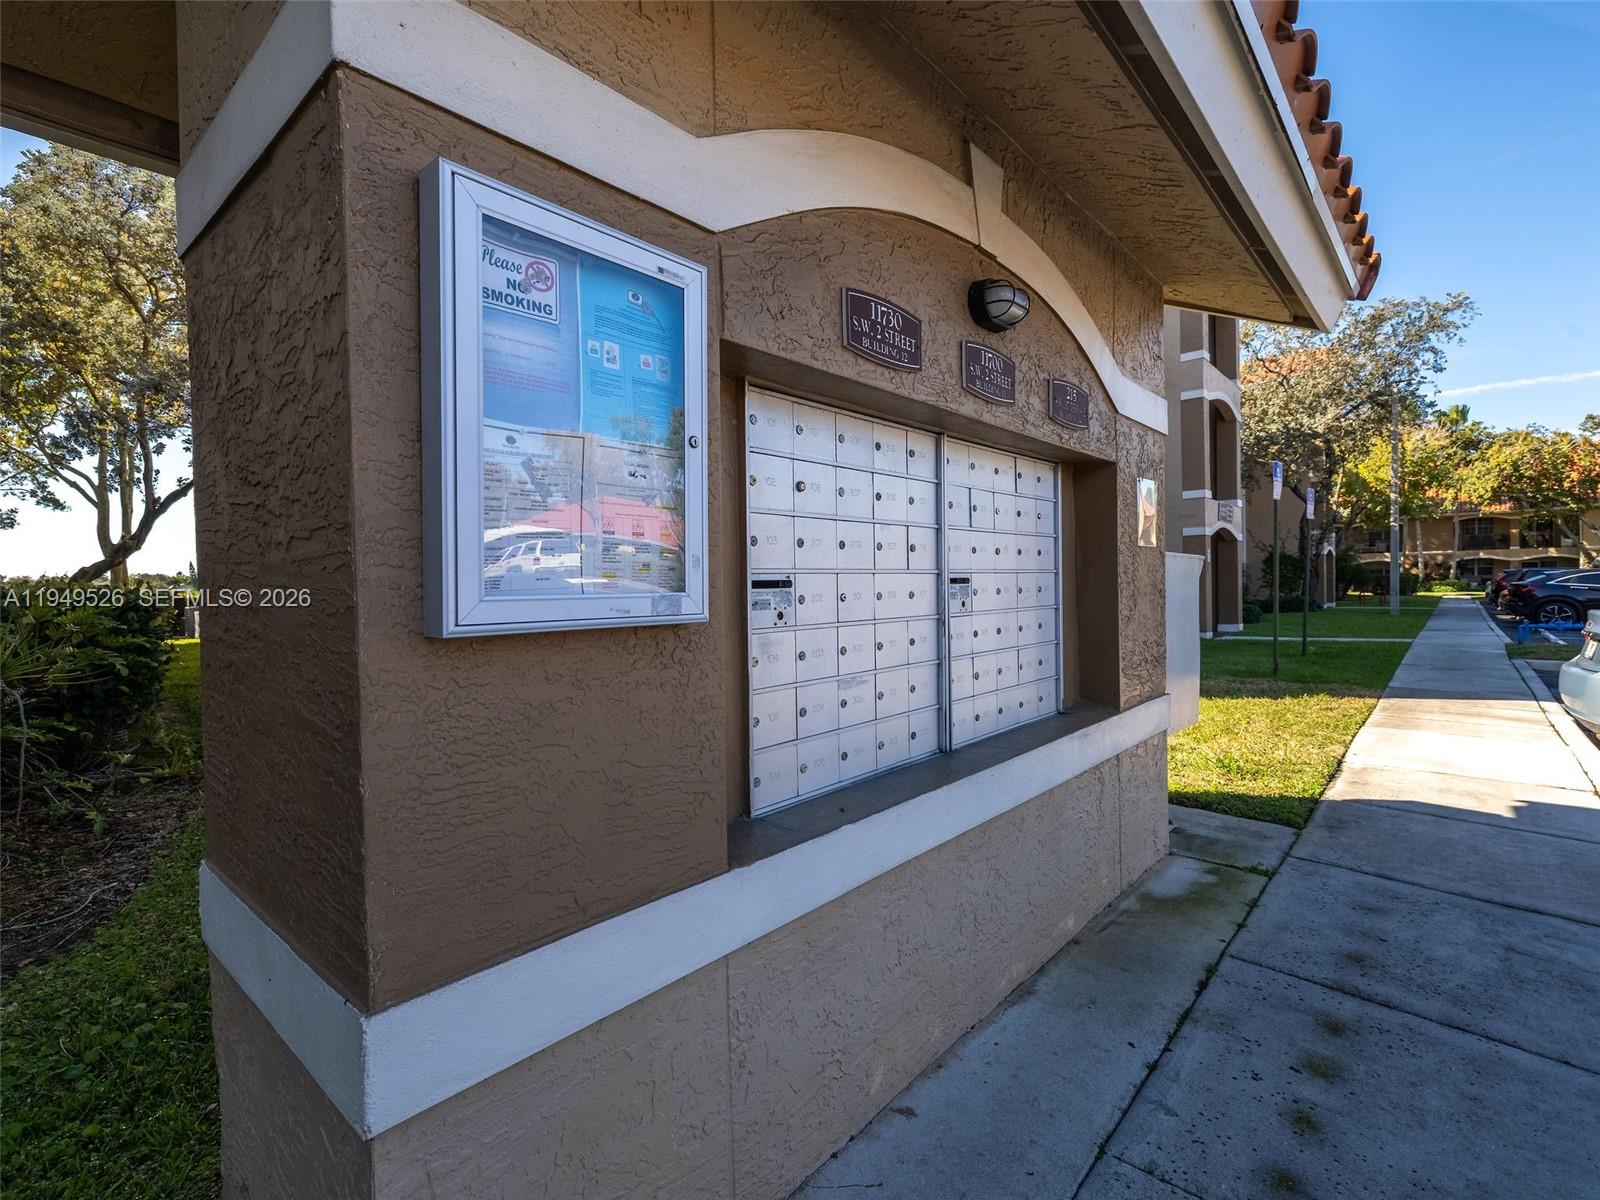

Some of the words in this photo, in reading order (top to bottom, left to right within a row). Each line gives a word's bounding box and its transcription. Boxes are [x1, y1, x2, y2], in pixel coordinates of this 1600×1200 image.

[482, 245, 523, 275] Please
[482, 286, 553, 316] SMOKING
[871, 302, 903, 331] 11730
[853, 315, 874, 337] S.W.
[876, 325, 882, 339] 2
[884, 328, 916, 352] STREET
[862, 336, 900, 359] BUILDING
[901, 351, 908, 362] 12
[981, 350, 1004, 373] 11700
[985, 368, 990, 381] 2
[990, 371, 1012, 390] STREET
[766, 535, 778, 546] 103
